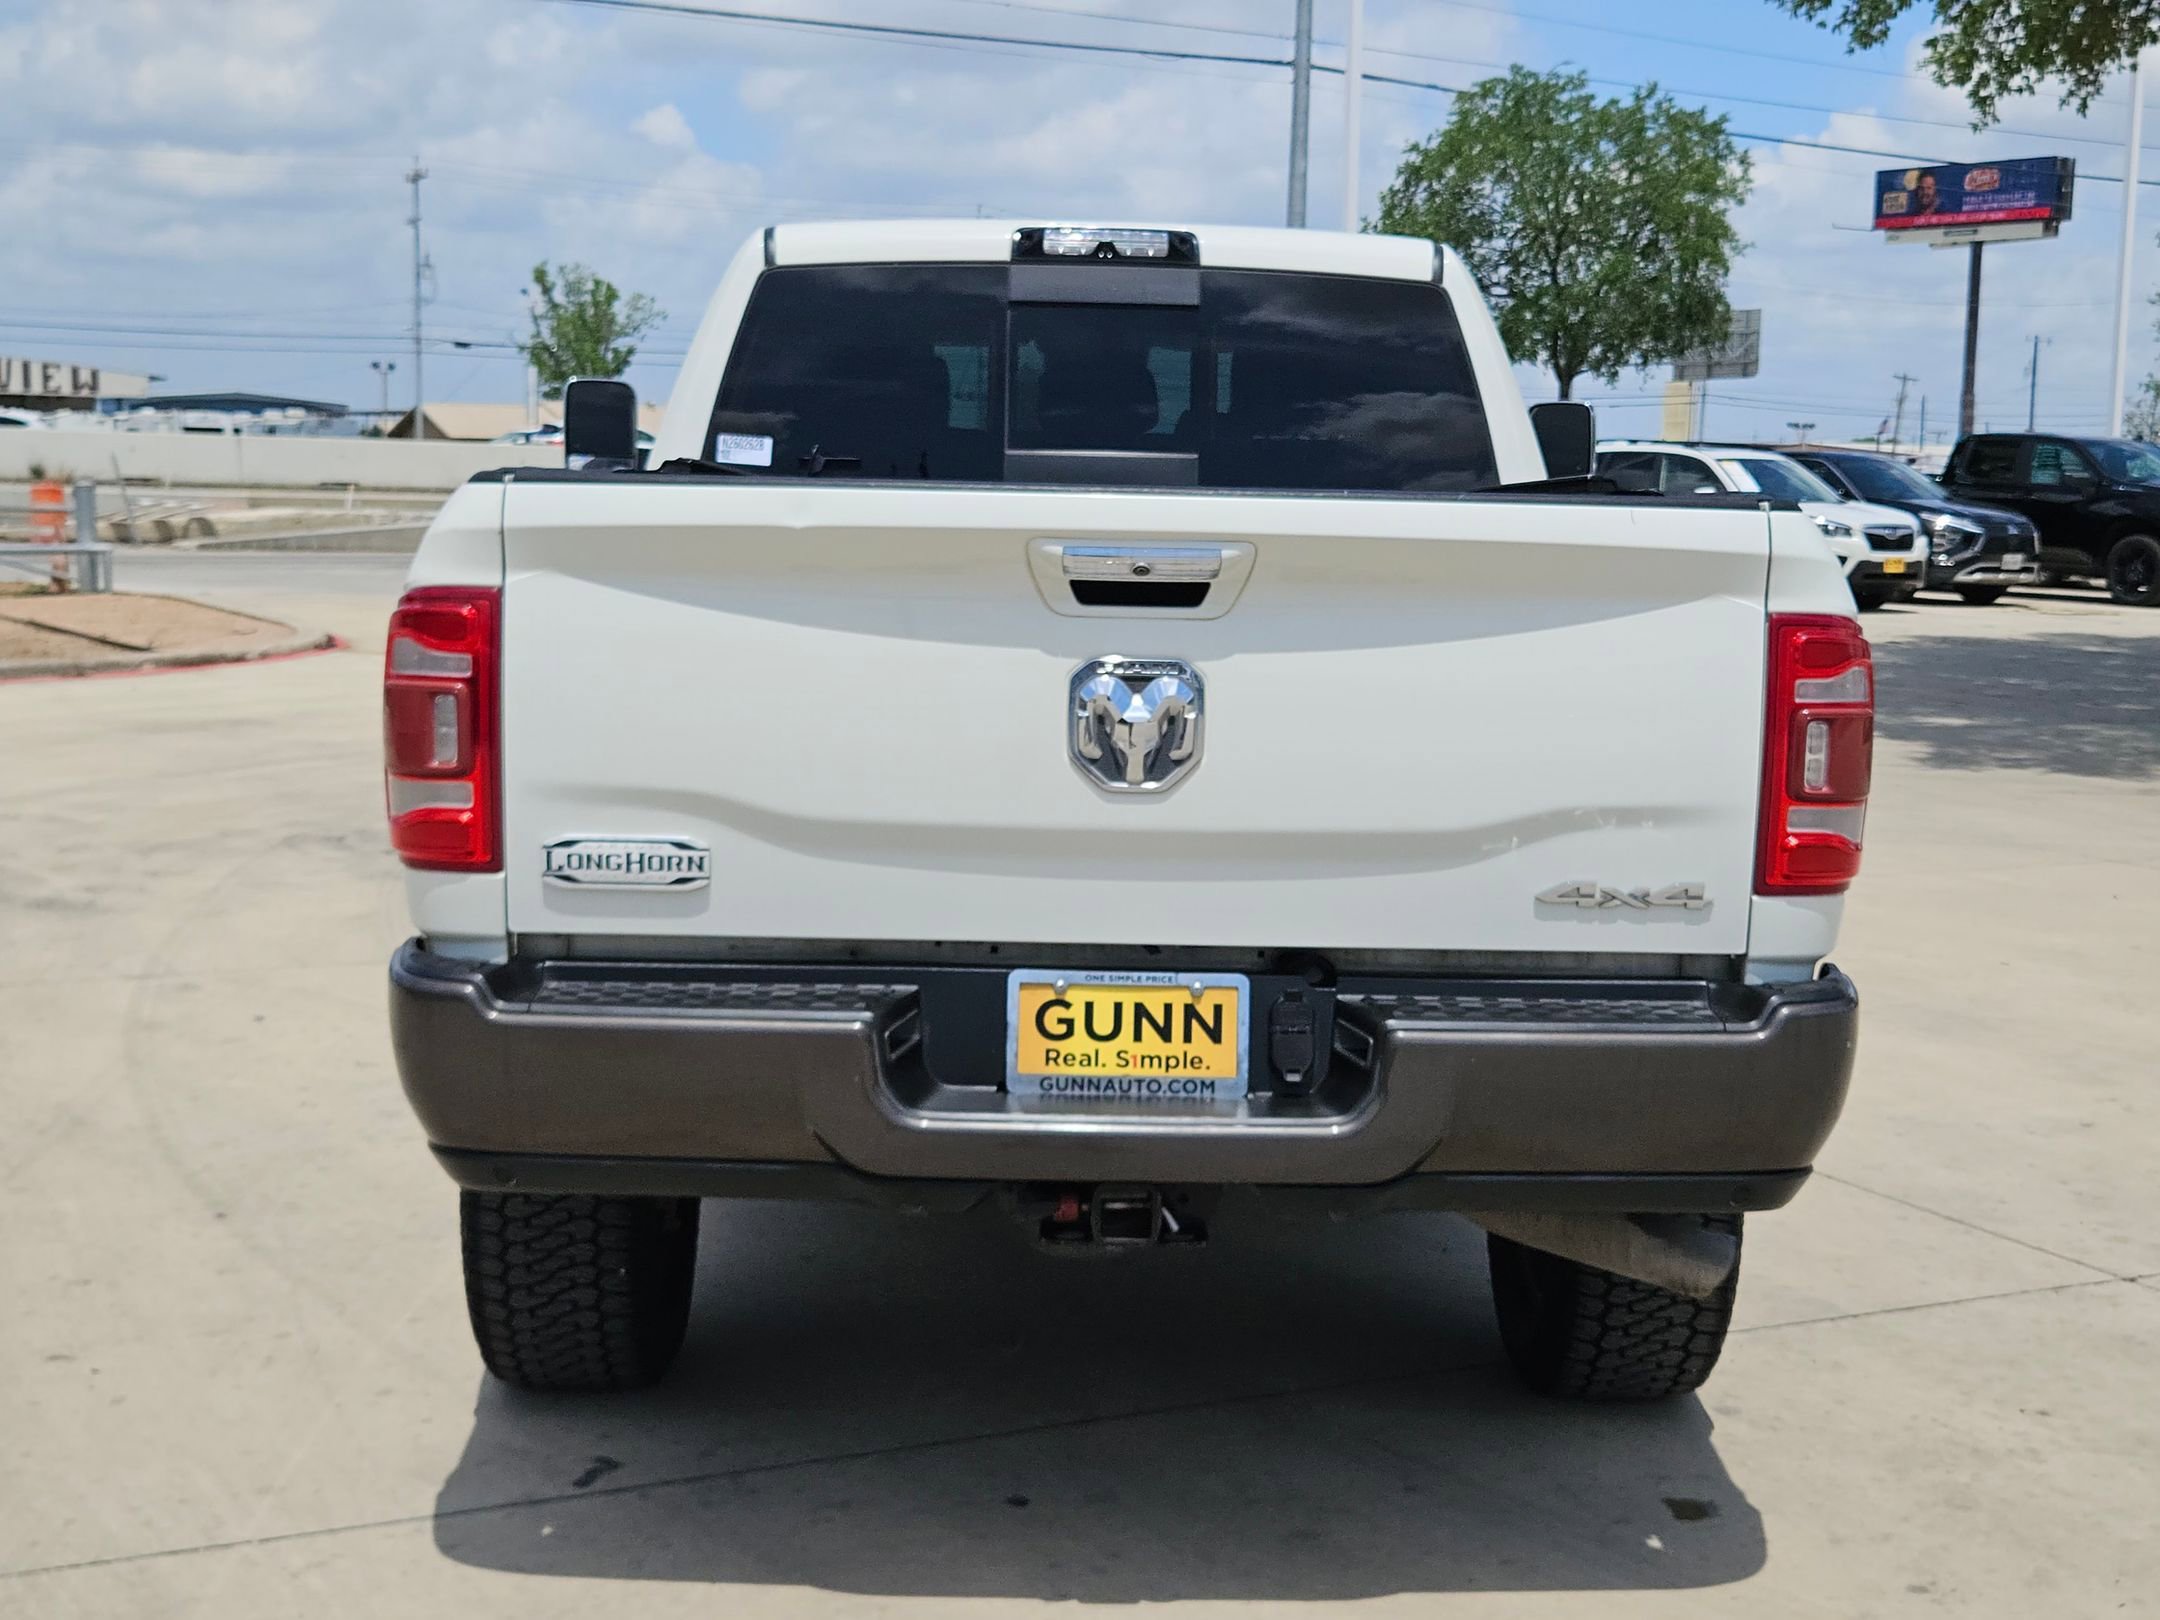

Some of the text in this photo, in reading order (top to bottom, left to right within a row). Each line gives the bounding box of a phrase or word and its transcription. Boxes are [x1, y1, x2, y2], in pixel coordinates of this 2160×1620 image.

[1084, 974, 1173, 984] ONE SIMPLE PRICE
[1035, 999, 1223, 1045] GUNN
[1045, 1048, 1106, 1068] Real.
[1039, 1077, 1215, 1095] GUNNAUTO.COM
